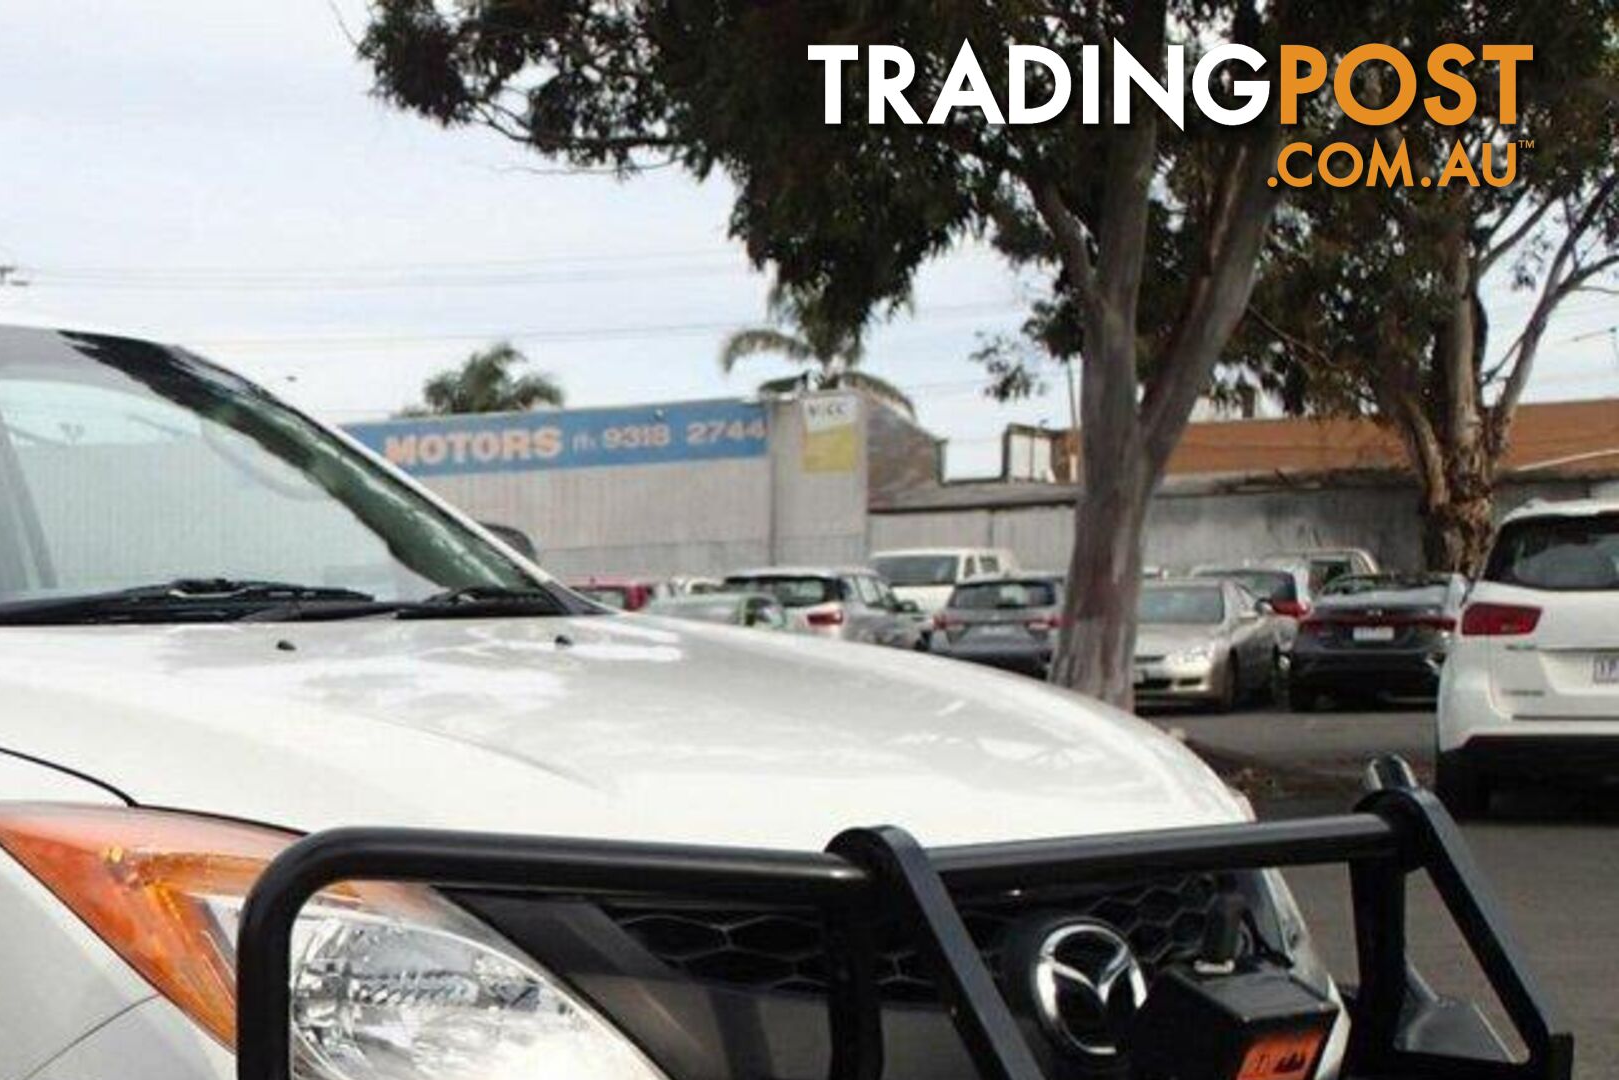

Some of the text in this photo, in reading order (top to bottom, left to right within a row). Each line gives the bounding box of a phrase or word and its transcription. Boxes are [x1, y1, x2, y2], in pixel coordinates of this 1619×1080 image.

[385, 427, 561, 466] MOTORS
[604, 423, 671, 449] 9318
[686, 417, 769, 444] 2744
